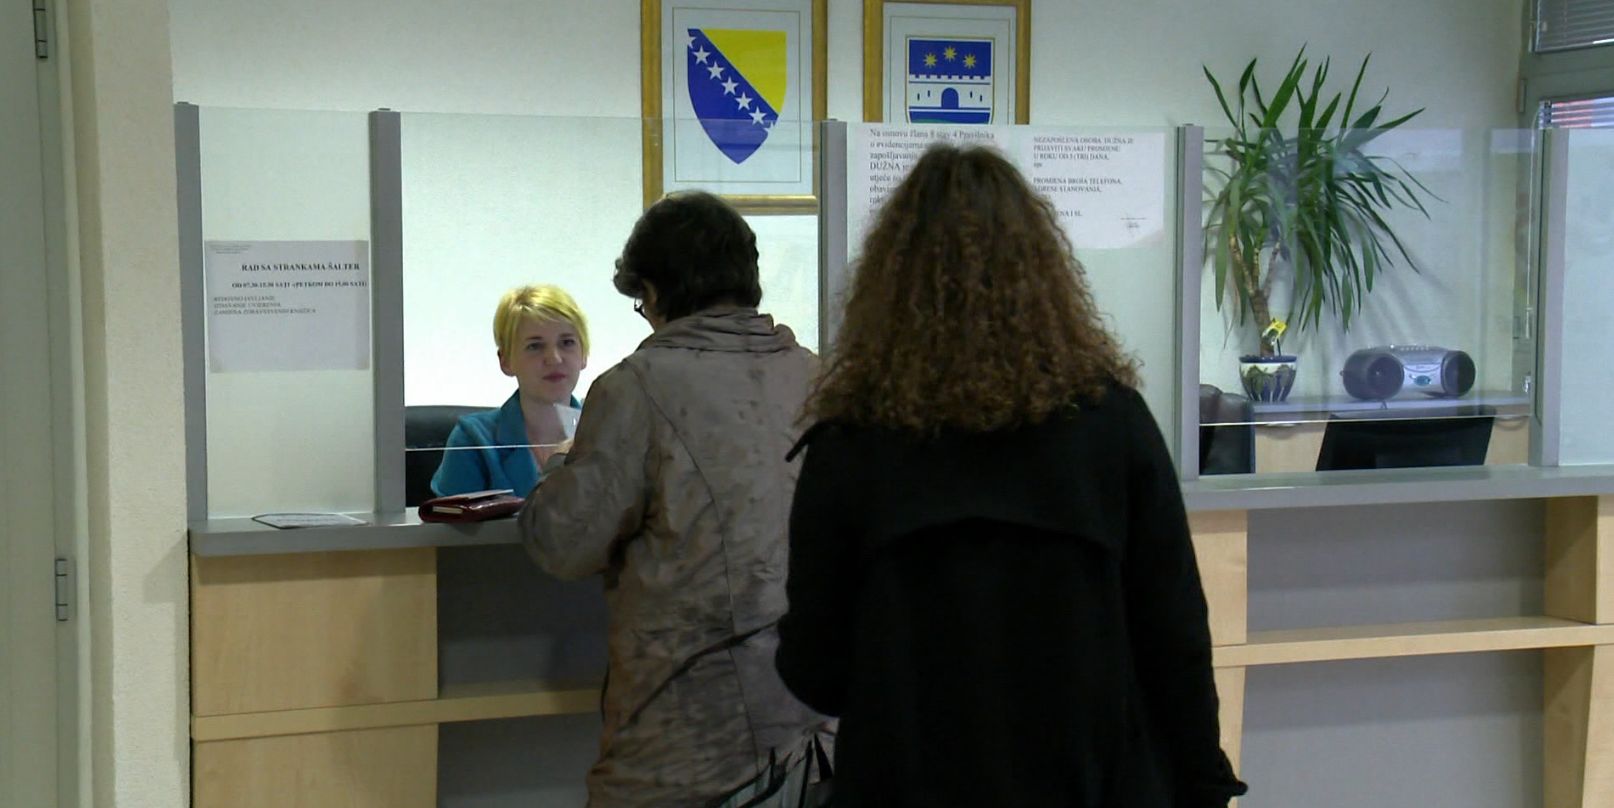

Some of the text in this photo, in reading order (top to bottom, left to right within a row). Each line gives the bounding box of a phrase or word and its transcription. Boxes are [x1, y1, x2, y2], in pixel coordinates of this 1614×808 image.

[870, 129, 880, 138] Na
[870, 161, 901, 170] DUŽNA
[273, 263, 326, 271] STRANKAMA
[328, 261, 360, 270] ŠALTER
